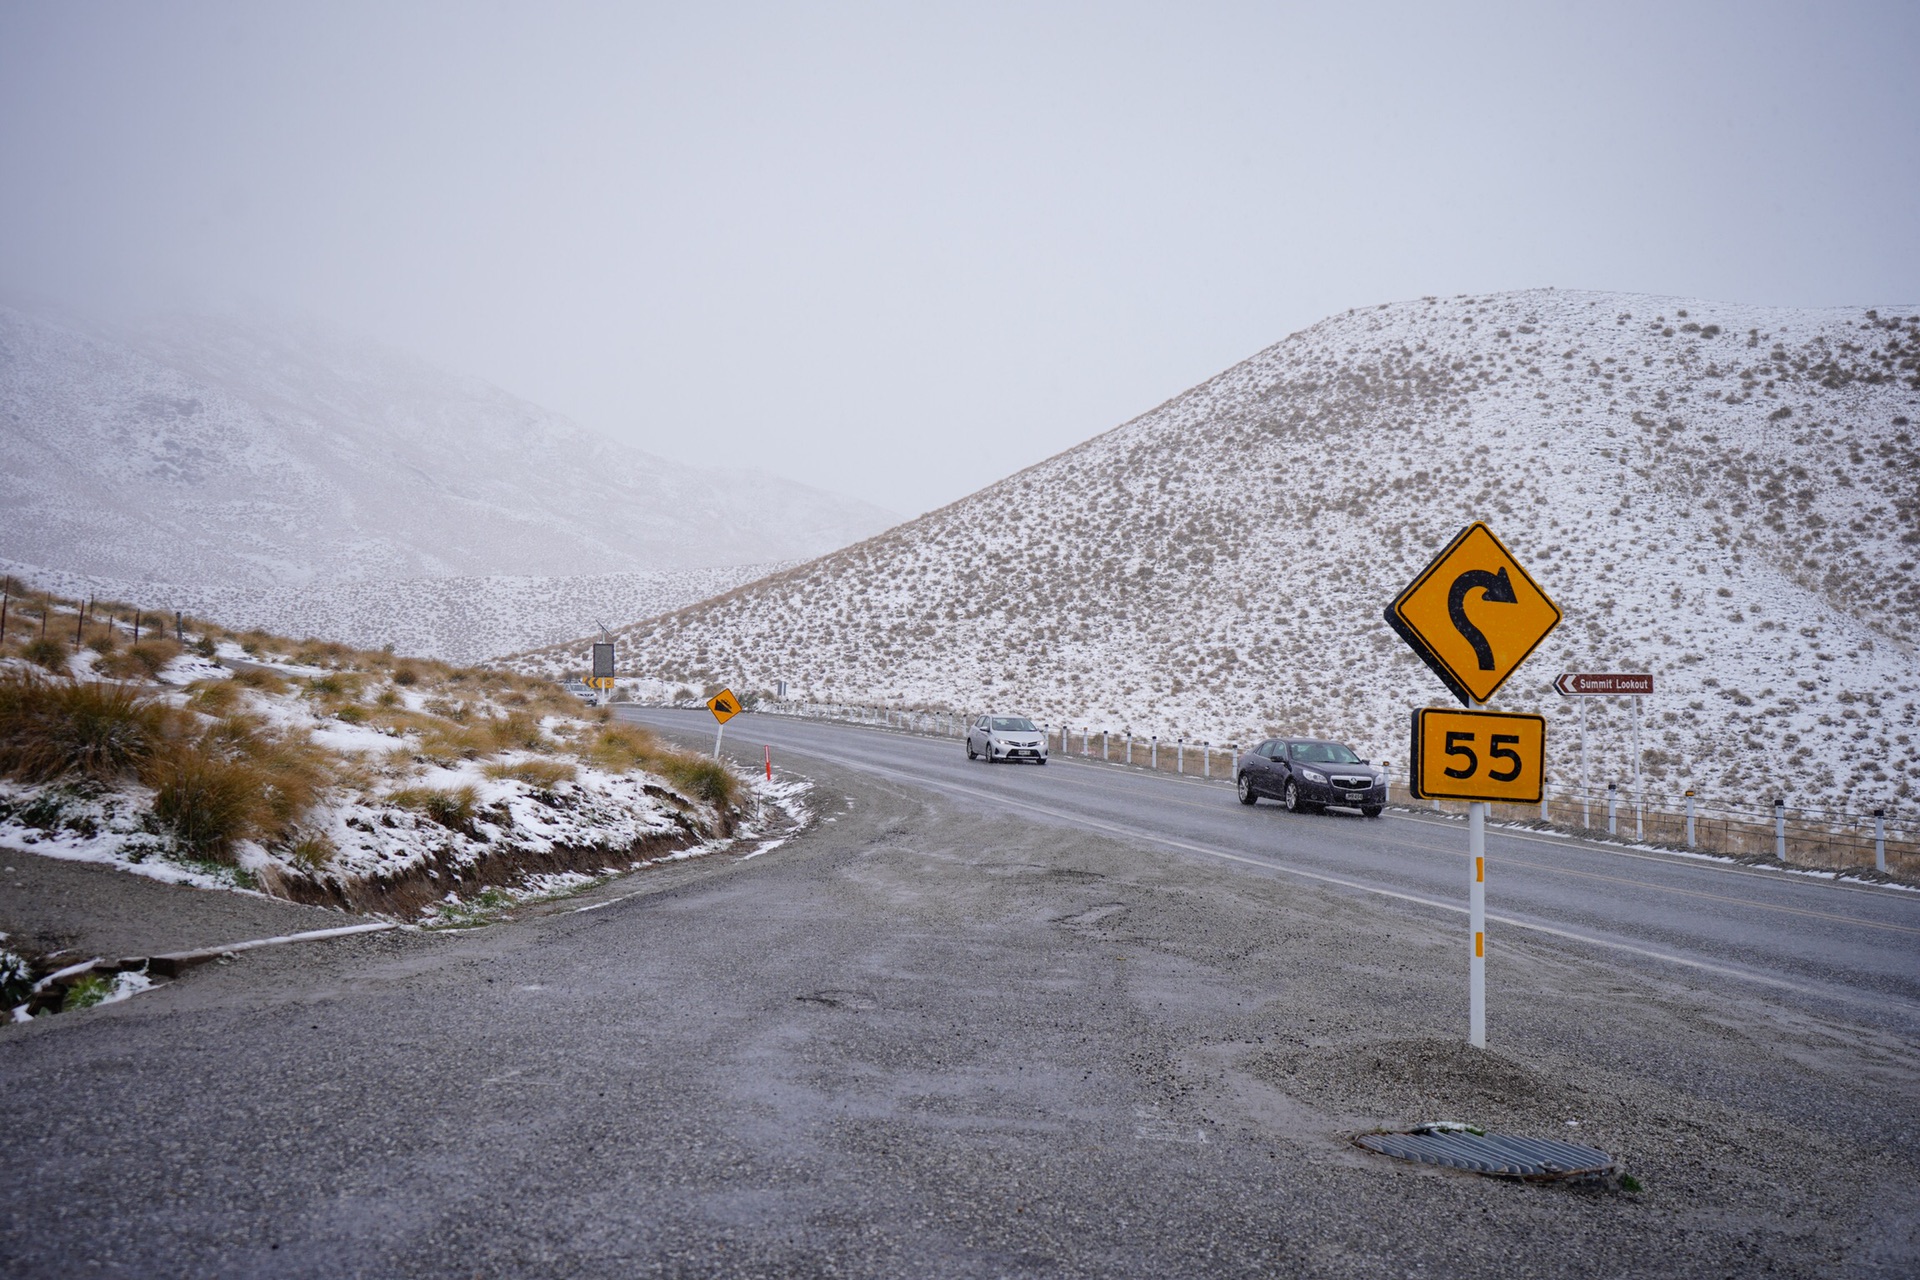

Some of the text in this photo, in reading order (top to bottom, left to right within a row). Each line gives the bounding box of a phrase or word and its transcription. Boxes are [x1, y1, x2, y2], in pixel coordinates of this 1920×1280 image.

[1580, 679, 1648, 689] Summit Lookout
[1443, 731, 1522, 782] 55
